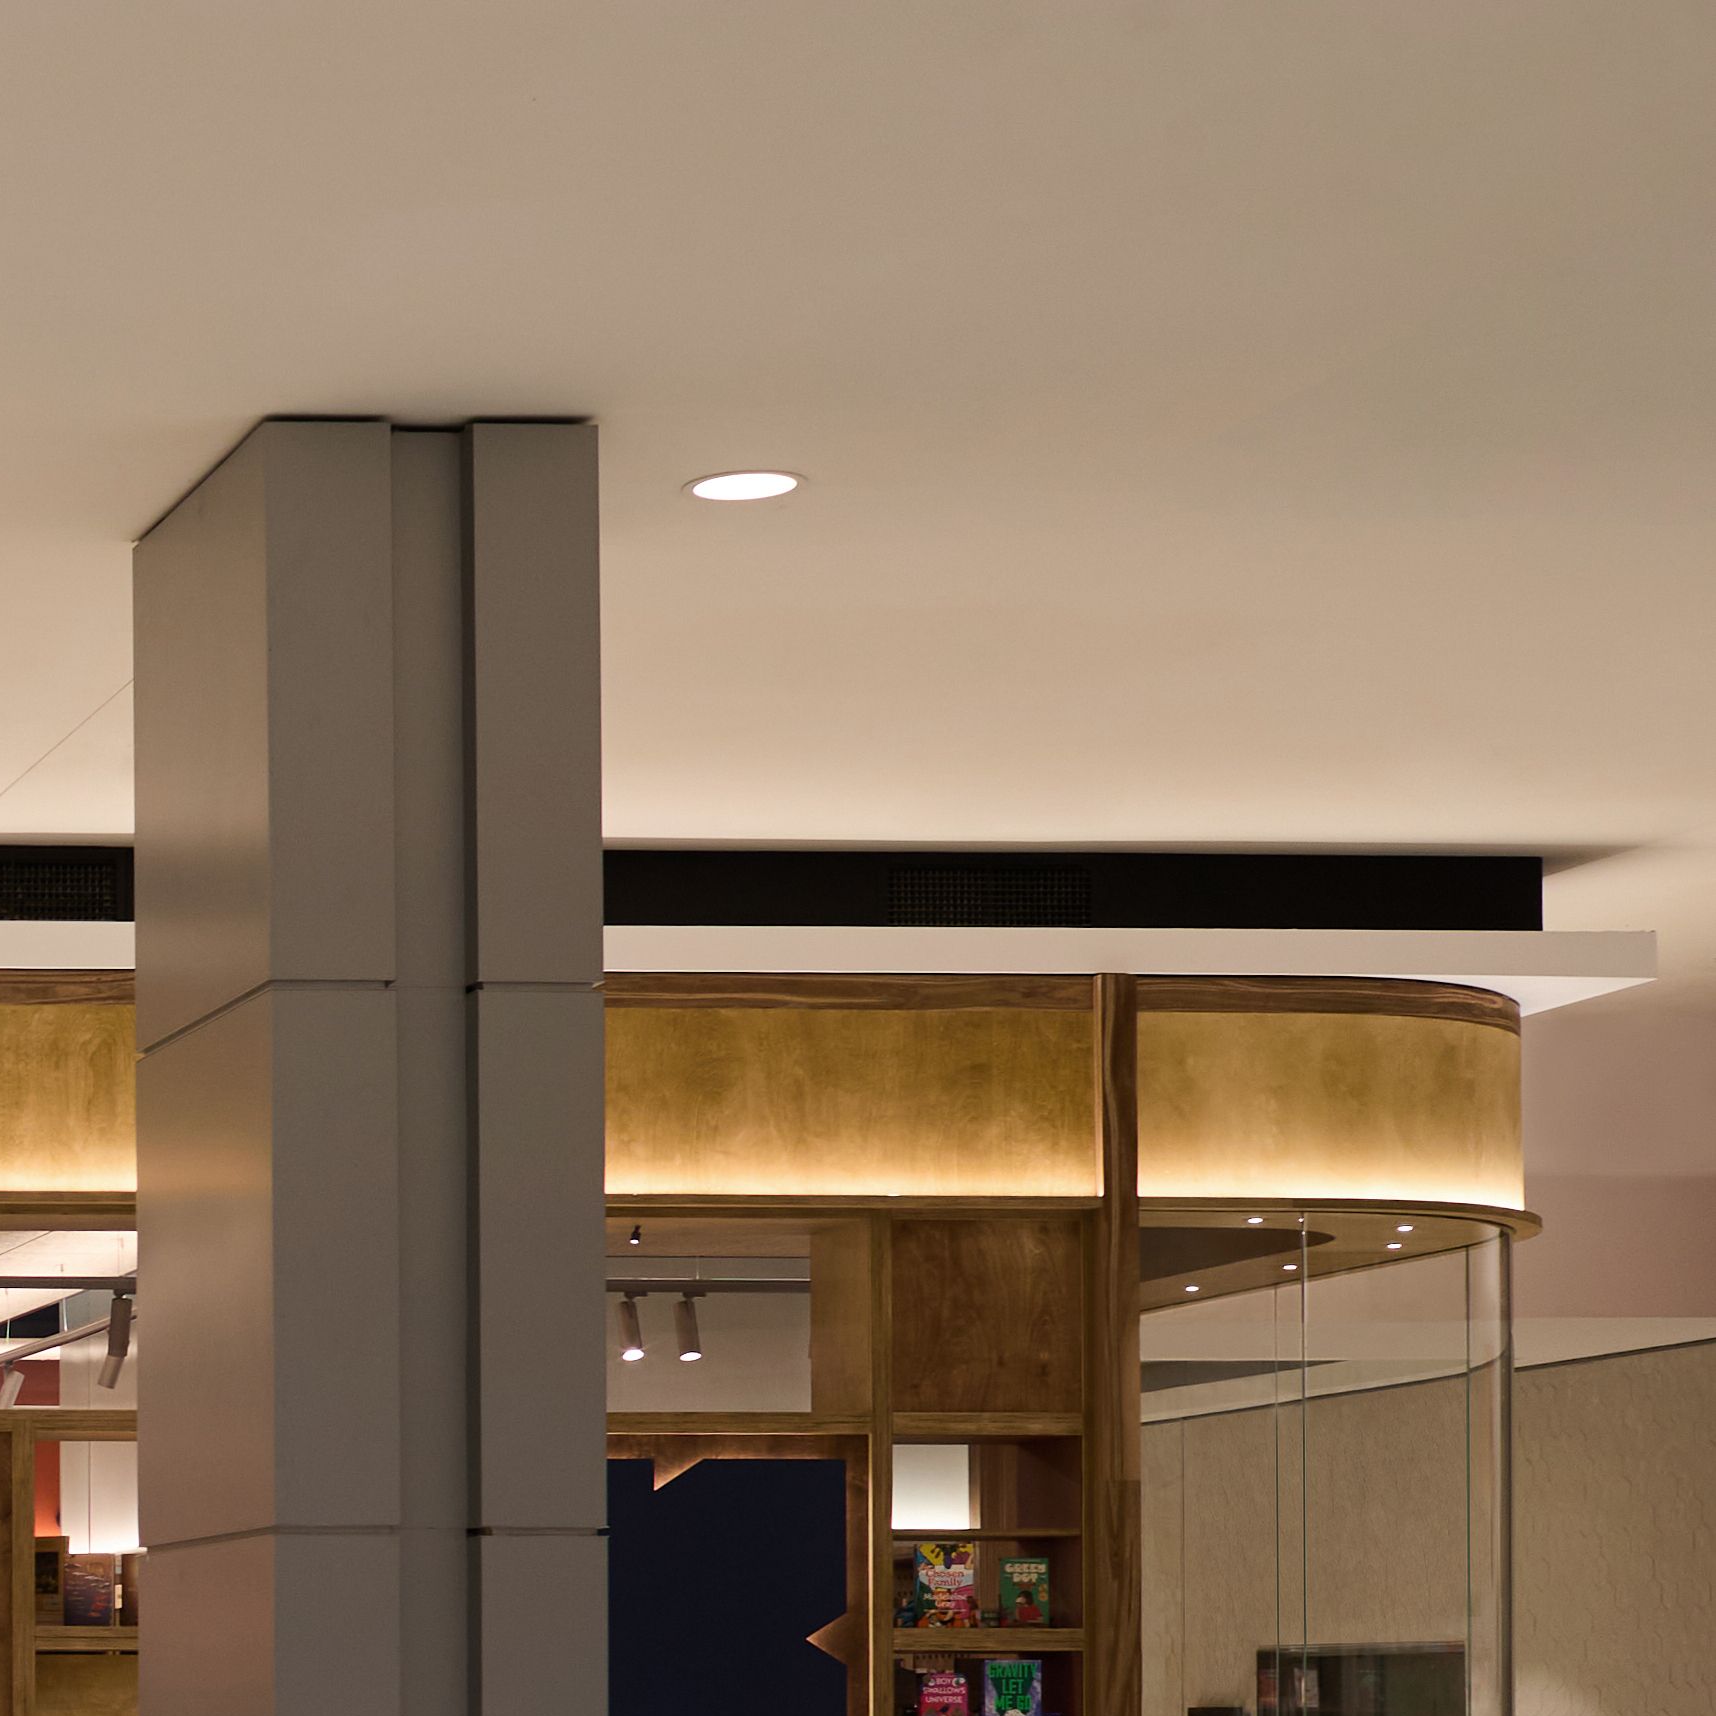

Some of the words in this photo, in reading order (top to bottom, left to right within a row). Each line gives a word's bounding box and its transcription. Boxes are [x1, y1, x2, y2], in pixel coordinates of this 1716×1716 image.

[925, 1569, 965, 1577] Chosen
[1005, 1563, 1046, 1573] GREEN
[928, 1577, 962, 1587] Family
[1012, 1573, 1038, 1582] DOT
[988, 1663, 1038, 1678] GRAVITY
[1002, 1679, 1024, 1694] LET
[925, 1696, 963, 1704] UNIVERSE
[995, 1695, 1014, 1711] ME
[1015, 1695, 1032, 1710] GO
